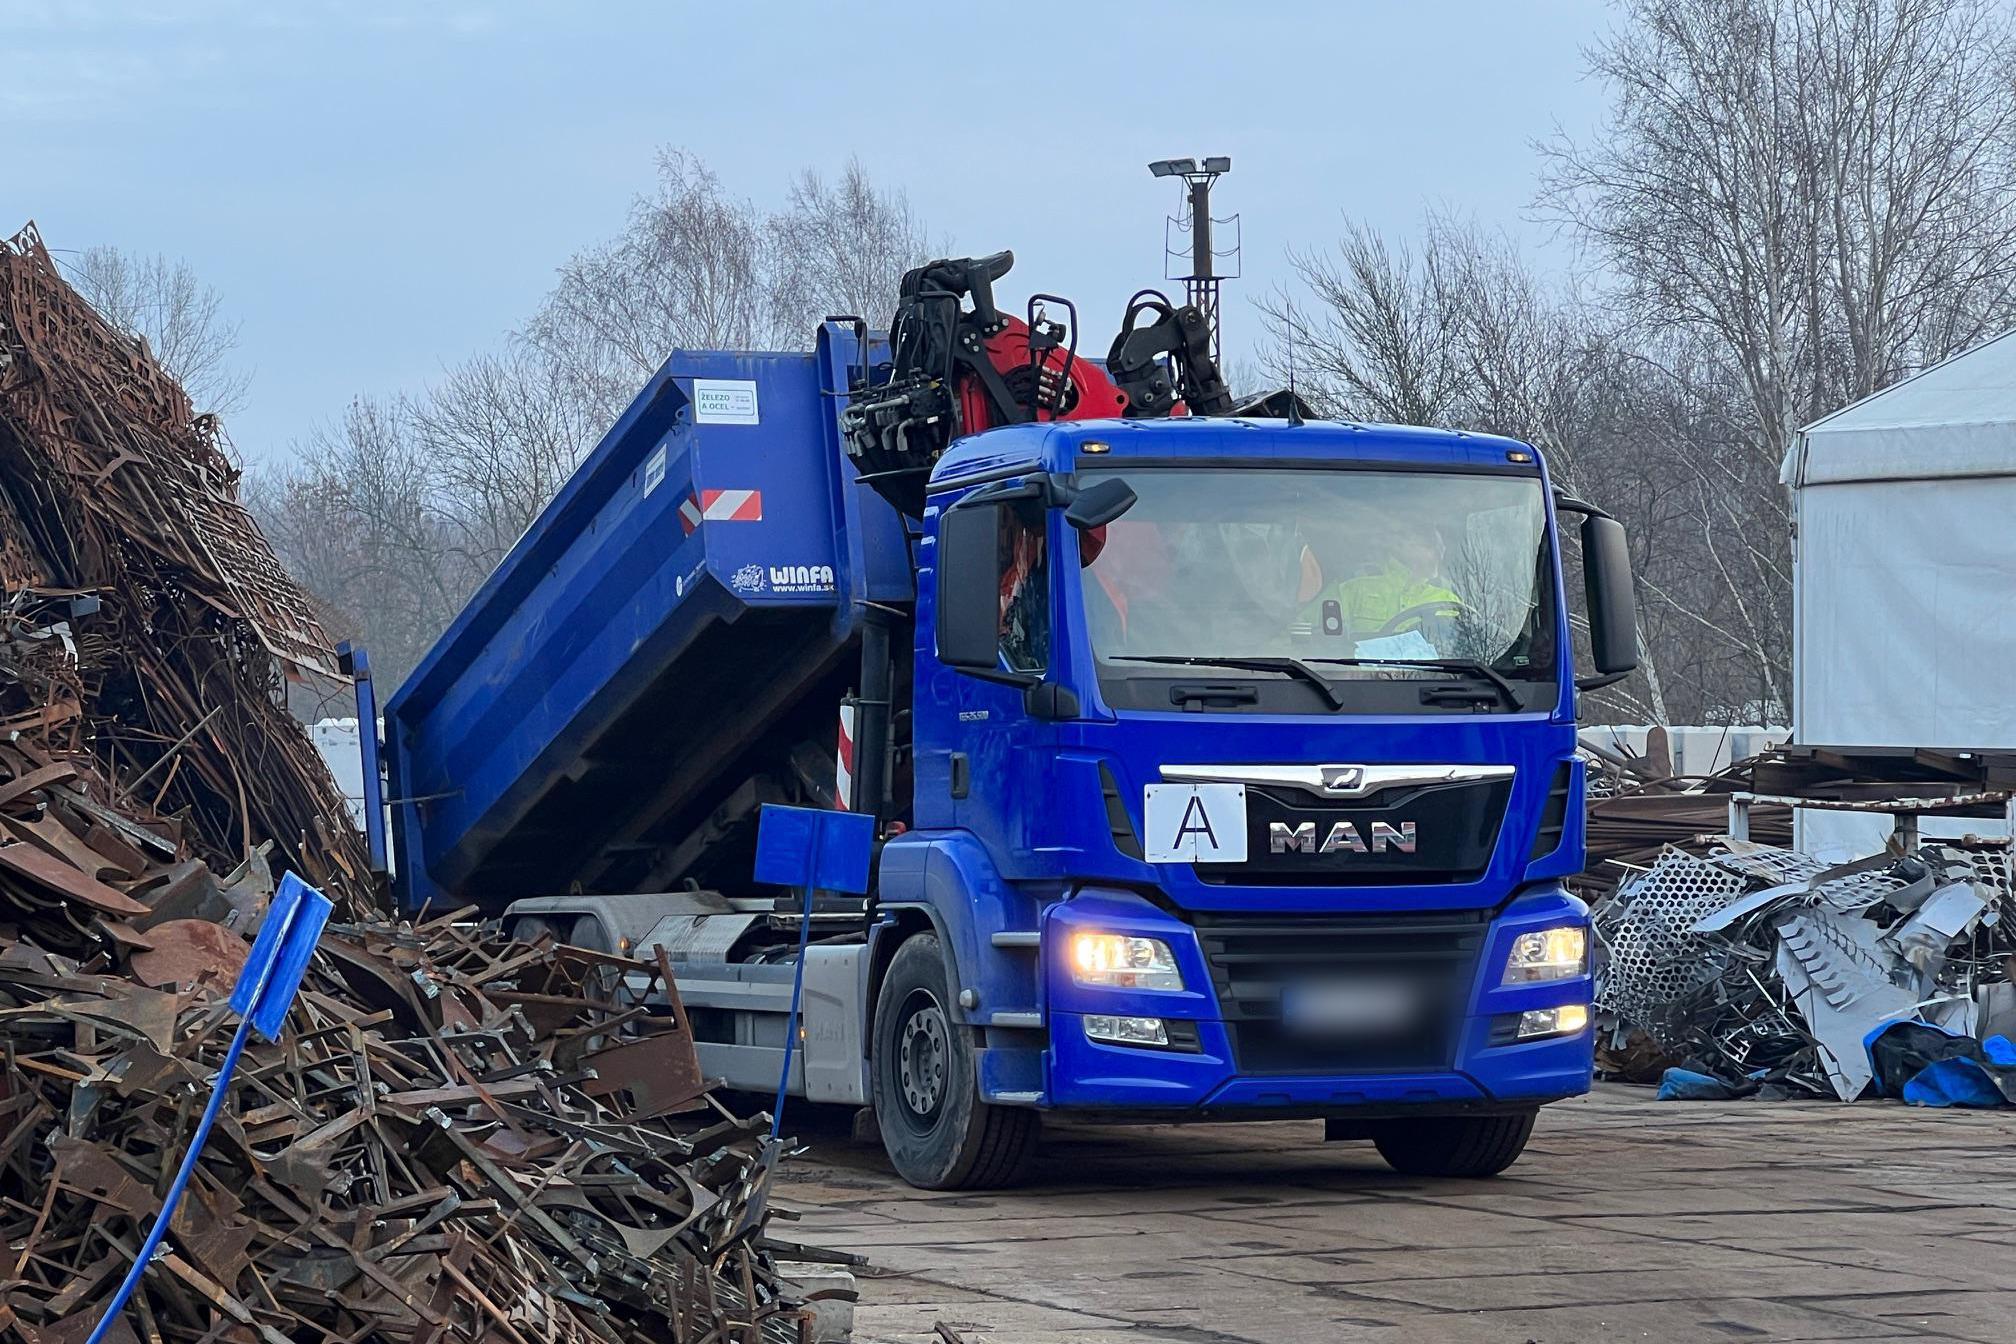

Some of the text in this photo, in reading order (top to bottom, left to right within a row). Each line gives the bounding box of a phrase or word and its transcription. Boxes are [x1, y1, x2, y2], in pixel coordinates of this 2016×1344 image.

[769, 566, 834, 585] WINFA
[1173, 796, 1219, 850] A
[1270, 821, 1416, 853] MAN
